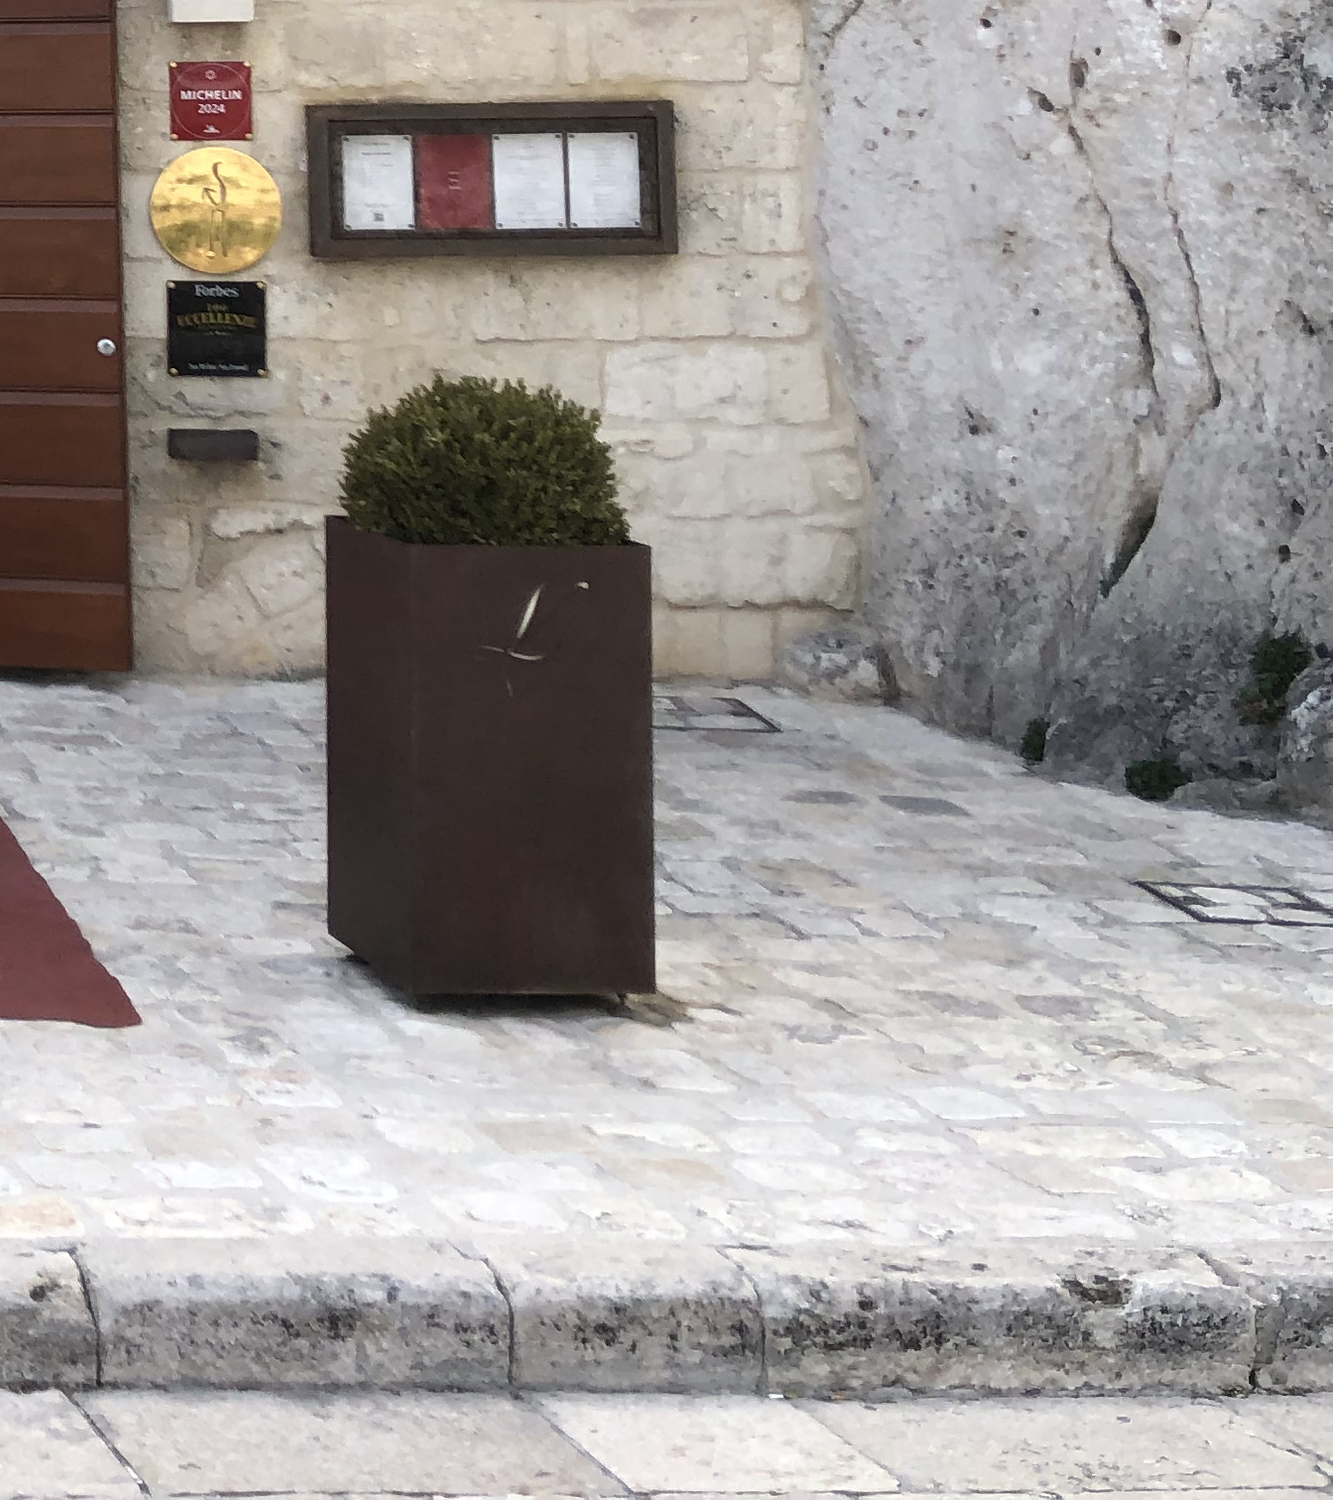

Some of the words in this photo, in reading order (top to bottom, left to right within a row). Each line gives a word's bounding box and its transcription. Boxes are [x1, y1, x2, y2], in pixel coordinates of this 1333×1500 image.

[180, 89, 243, 101] MICHELIN
[197, 103, 227, 115] 2024
[194, 283, 240, 298] Forbes
